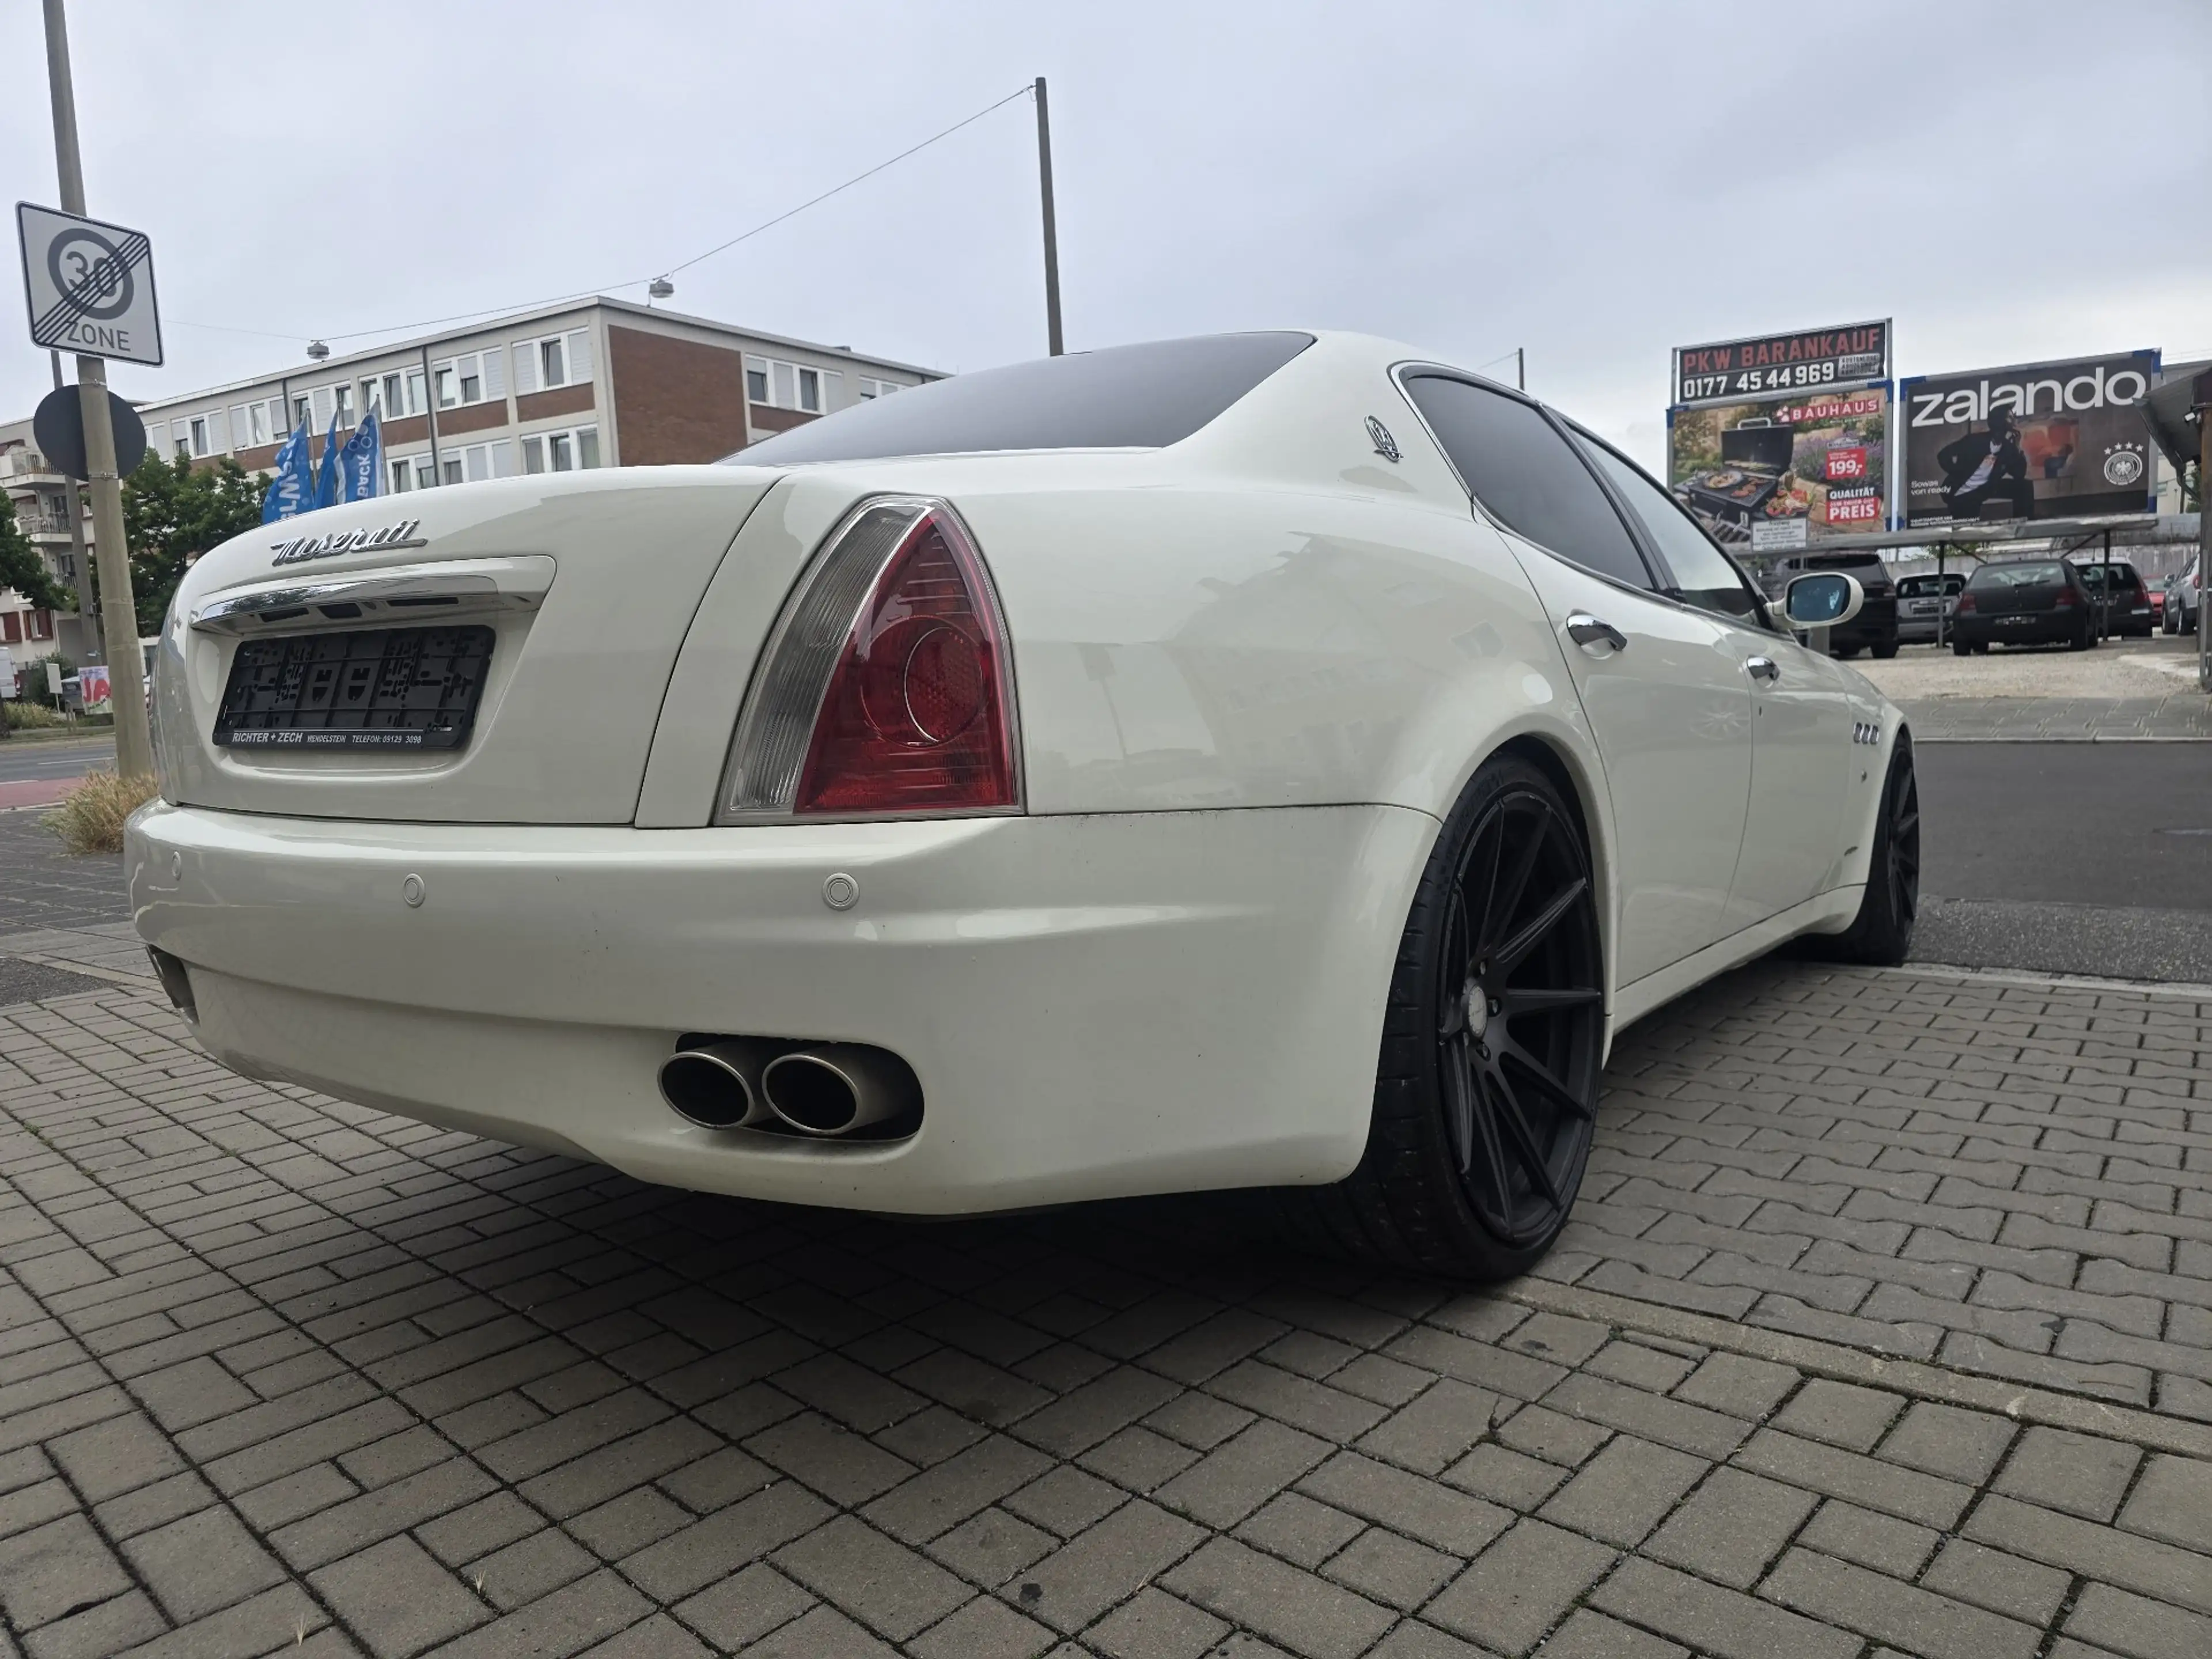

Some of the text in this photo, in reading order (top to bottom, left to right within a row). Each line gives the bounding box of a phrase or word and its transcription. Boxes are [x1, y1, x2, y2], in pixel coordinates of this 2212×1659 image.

[66, 251, 117, 297] 30
[66, 320, 131, 351] ZONE
[1684, 328, 1880, 373] PKW BARANKAUF
[1684, 376, 1728, 398] 0177
[1911, 366, 2146, 427] zalando
[1793, 399, 1877, 421] BAUHAUS
[1830, 486, 1874, 500] QUALITÄT
[1830, 503, 1875, 520] PREIS
[232, 732, 269, 743] RICHTER
[277, 732, 304, 743] ZECH
[306, 734, 346, 743] WENDELSTEIN
